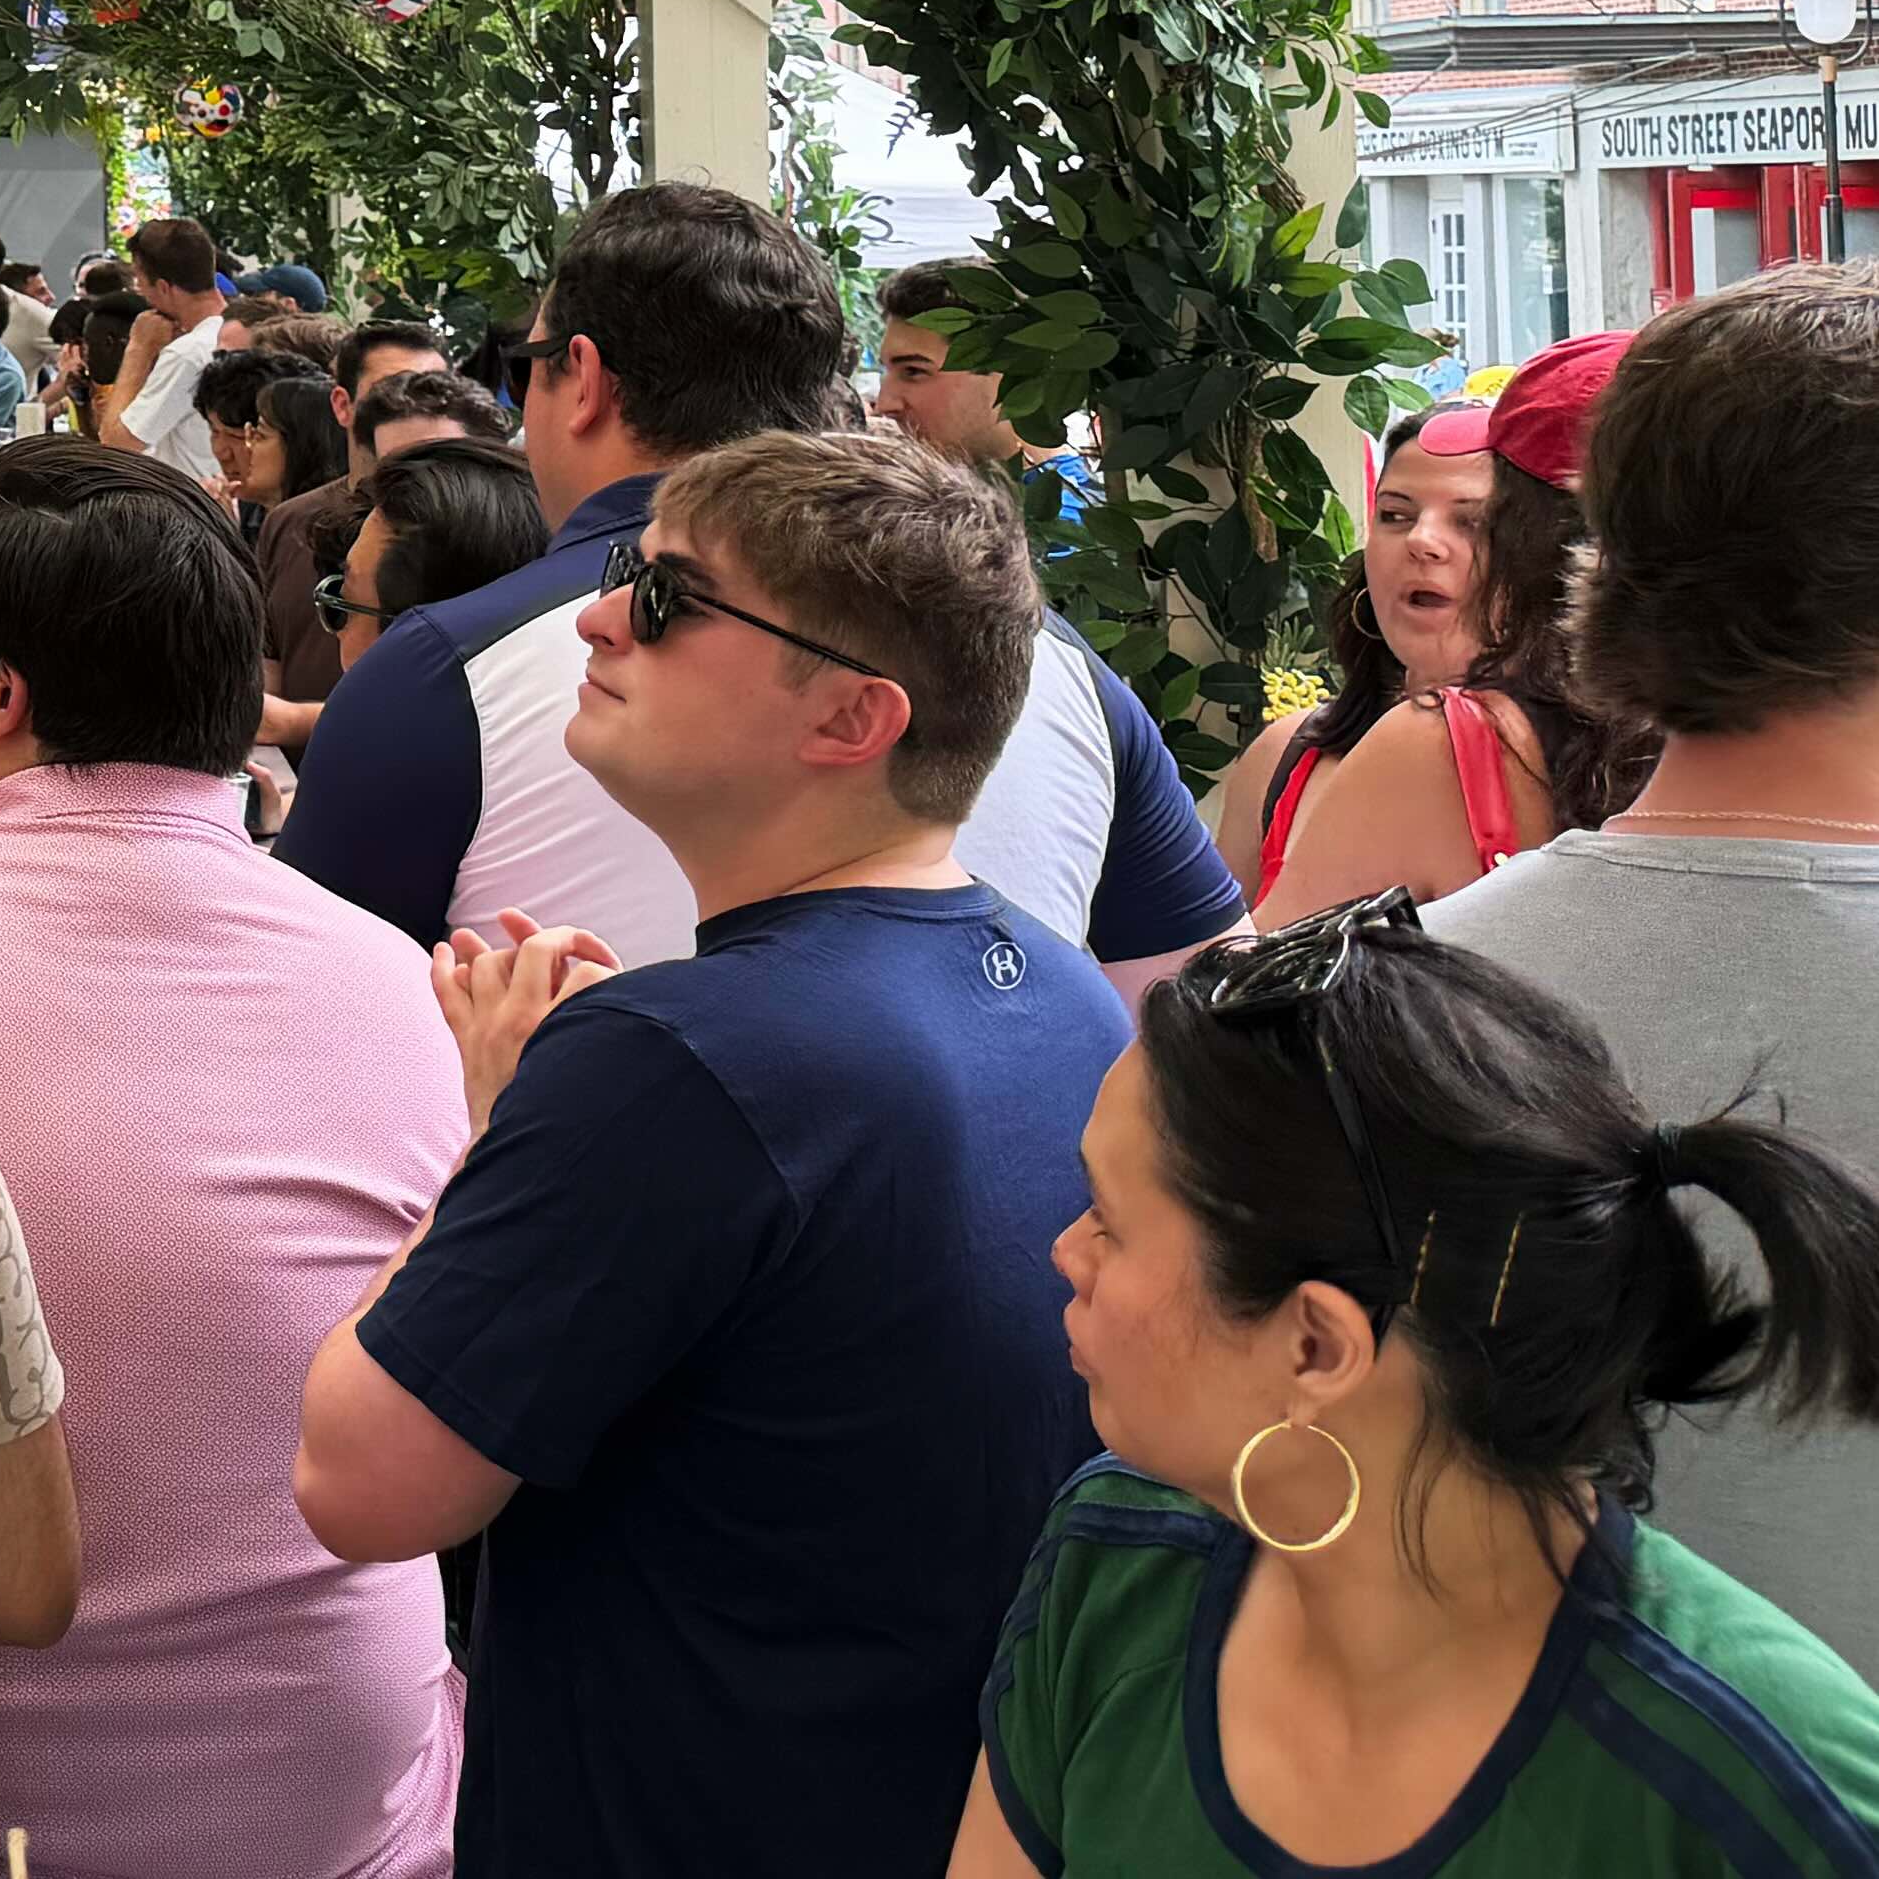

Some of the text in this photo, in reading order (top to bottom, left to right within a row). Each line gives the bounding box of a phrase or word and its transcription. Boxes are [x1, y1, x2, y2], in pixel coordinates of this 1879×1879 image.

[1602, 116, 1662, 157] SOUTH
[1667, 111, 1738, 155] STREET
[1743, 106, 1837, 152] SEAPOR
